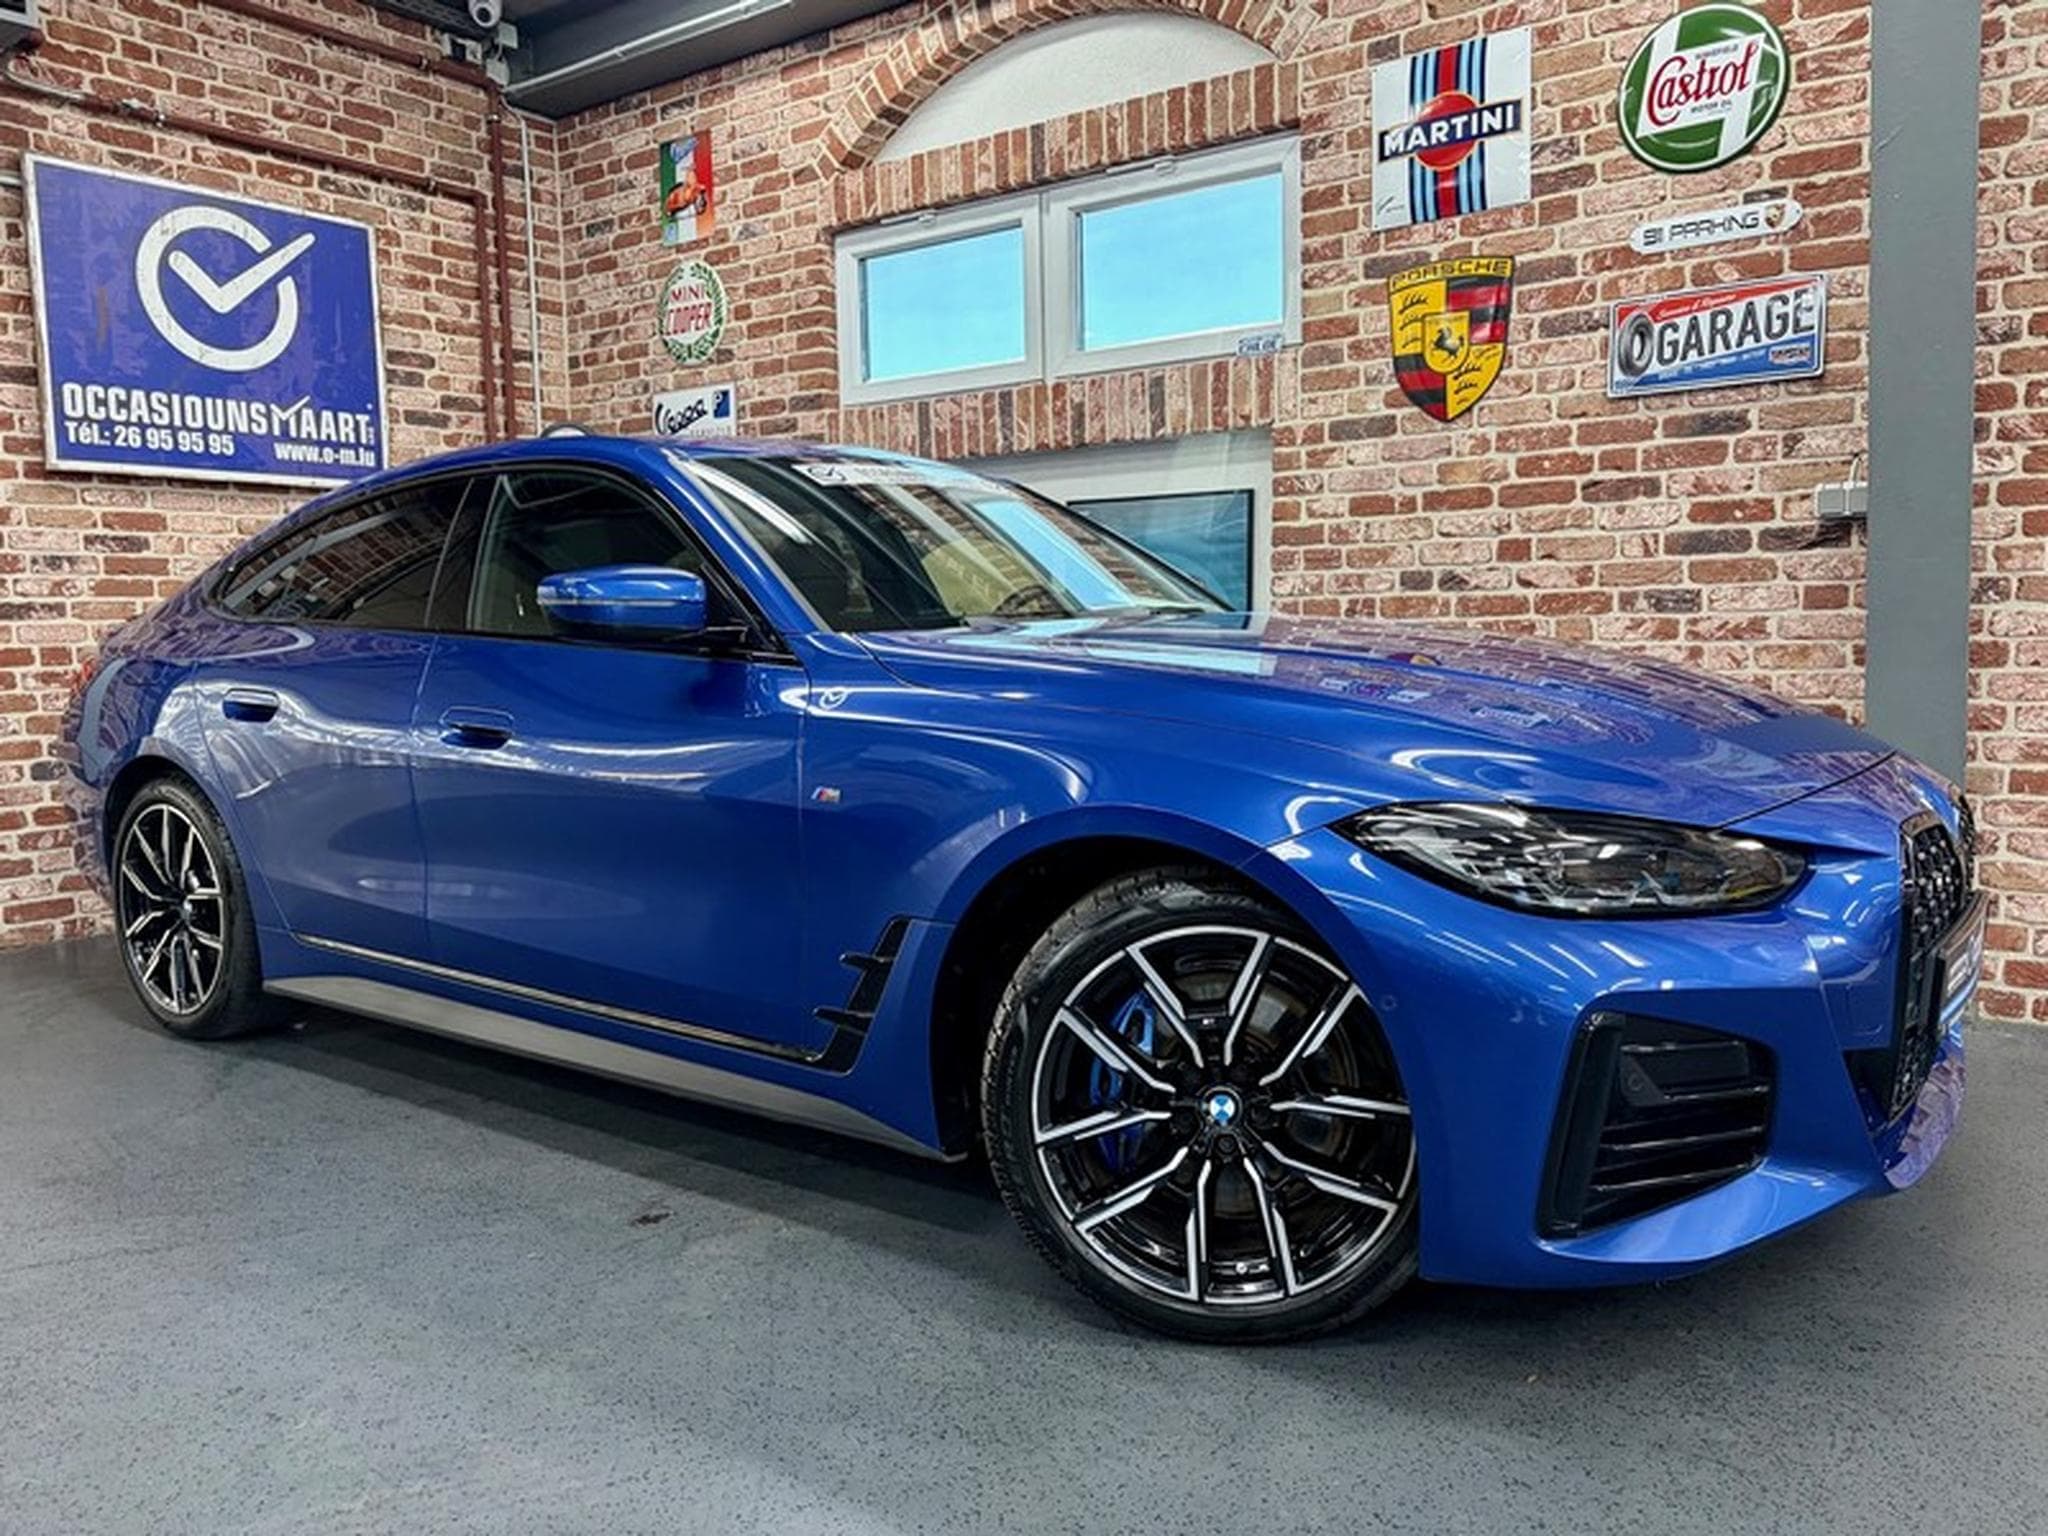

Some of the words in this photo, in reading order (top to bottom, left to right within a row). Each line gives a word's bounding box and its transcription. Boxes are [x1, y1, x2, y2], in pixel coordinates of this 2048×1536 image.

[1647, 41, 1760, 127] Castrol
[1383, 104, 1514, 158] MARTINI
[1668, 206, 1760, 241] PARKING
[1391, 259, 1508, 289] PORSCHE
[669, 284, 705, 303] MINI
[1656, 288, 1815, 367] GARAGE
[113, 424, 142, 449] 26
[145, 426, 174, 452] 95
[177, 429, 205, 454] 95
[208, 431, 235, 457] 95
[273, 442, 376, 467] www.o-m.lu
